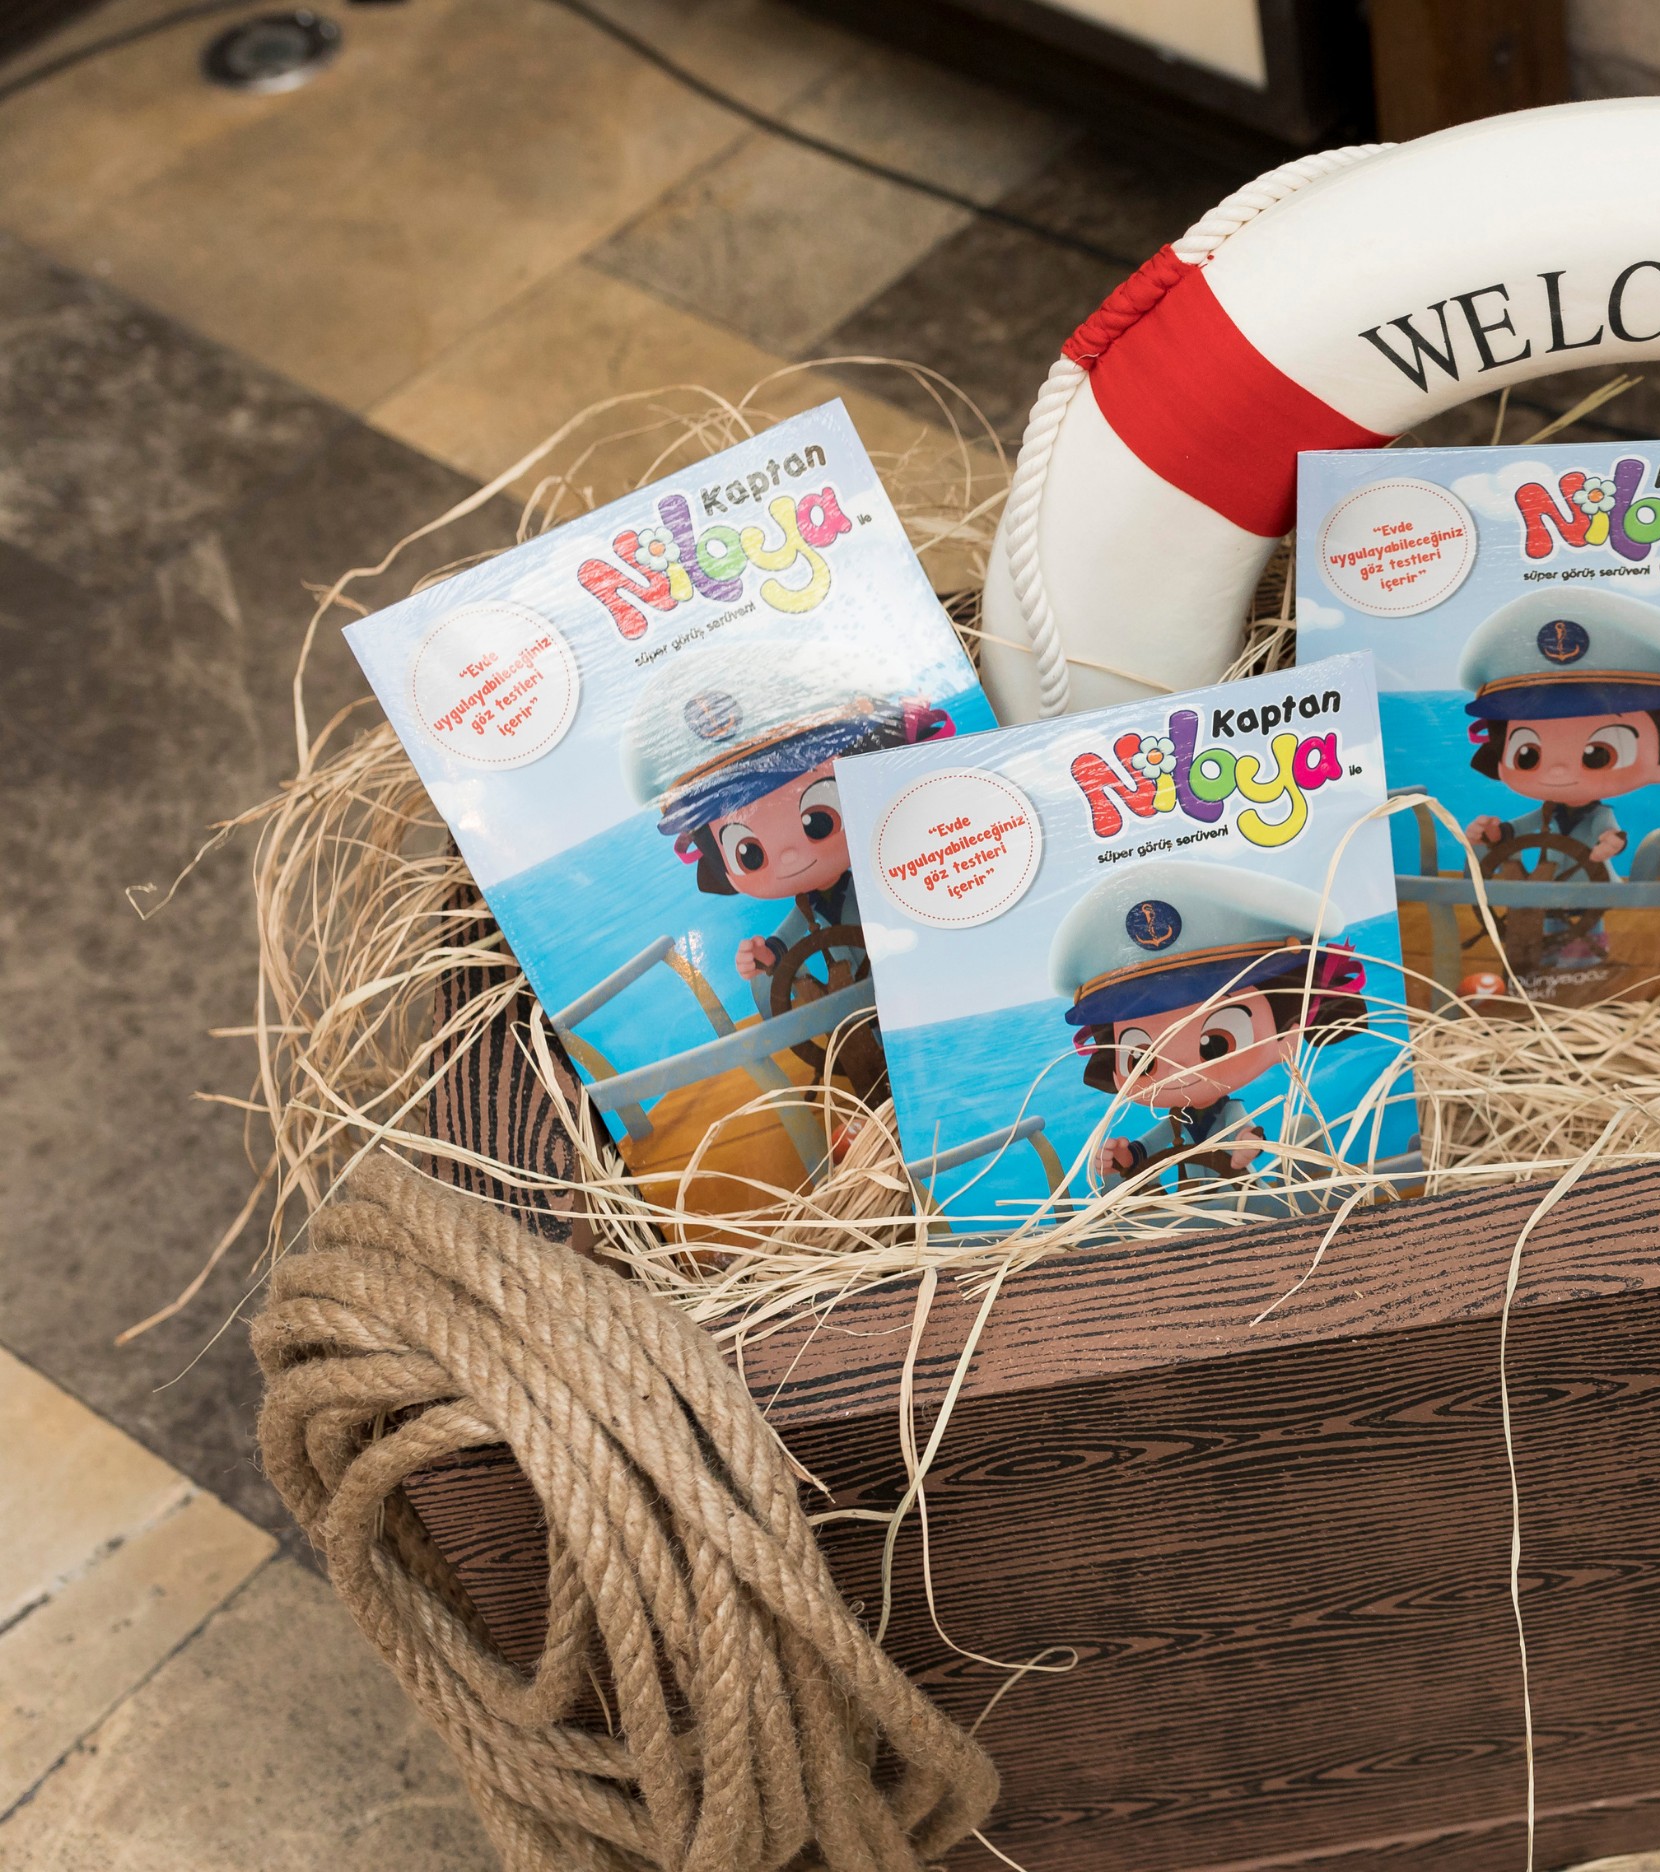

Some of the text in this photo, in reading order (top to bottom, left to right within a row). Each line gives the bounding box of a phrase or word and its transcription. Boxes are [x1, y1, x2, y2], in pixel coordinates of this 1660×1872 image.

[700, 445, 827, 516] Kaptan
[577, 486, 853, 640] Niloya
[1330, 527, 1464, 568] uygulayabileceğiniz
[1360, 549, 1441, 581] göz testleri
[1523, 565, 1650, 582] süper görüş serüveni
[434, 636, 552, 732] uygulayabileceğiniz
[471, 670, 544, 735] göz testleri
[1212, 690, 1341, 738] Kaptan
[1071, 710, 1343, 848] Niloya
[888, 815, 1025, 881] uygulayabileceğiniz
[924, 842, 1007, 891] göz testleri
[1098, 824, 1229, 863] süper görüş serüveni
